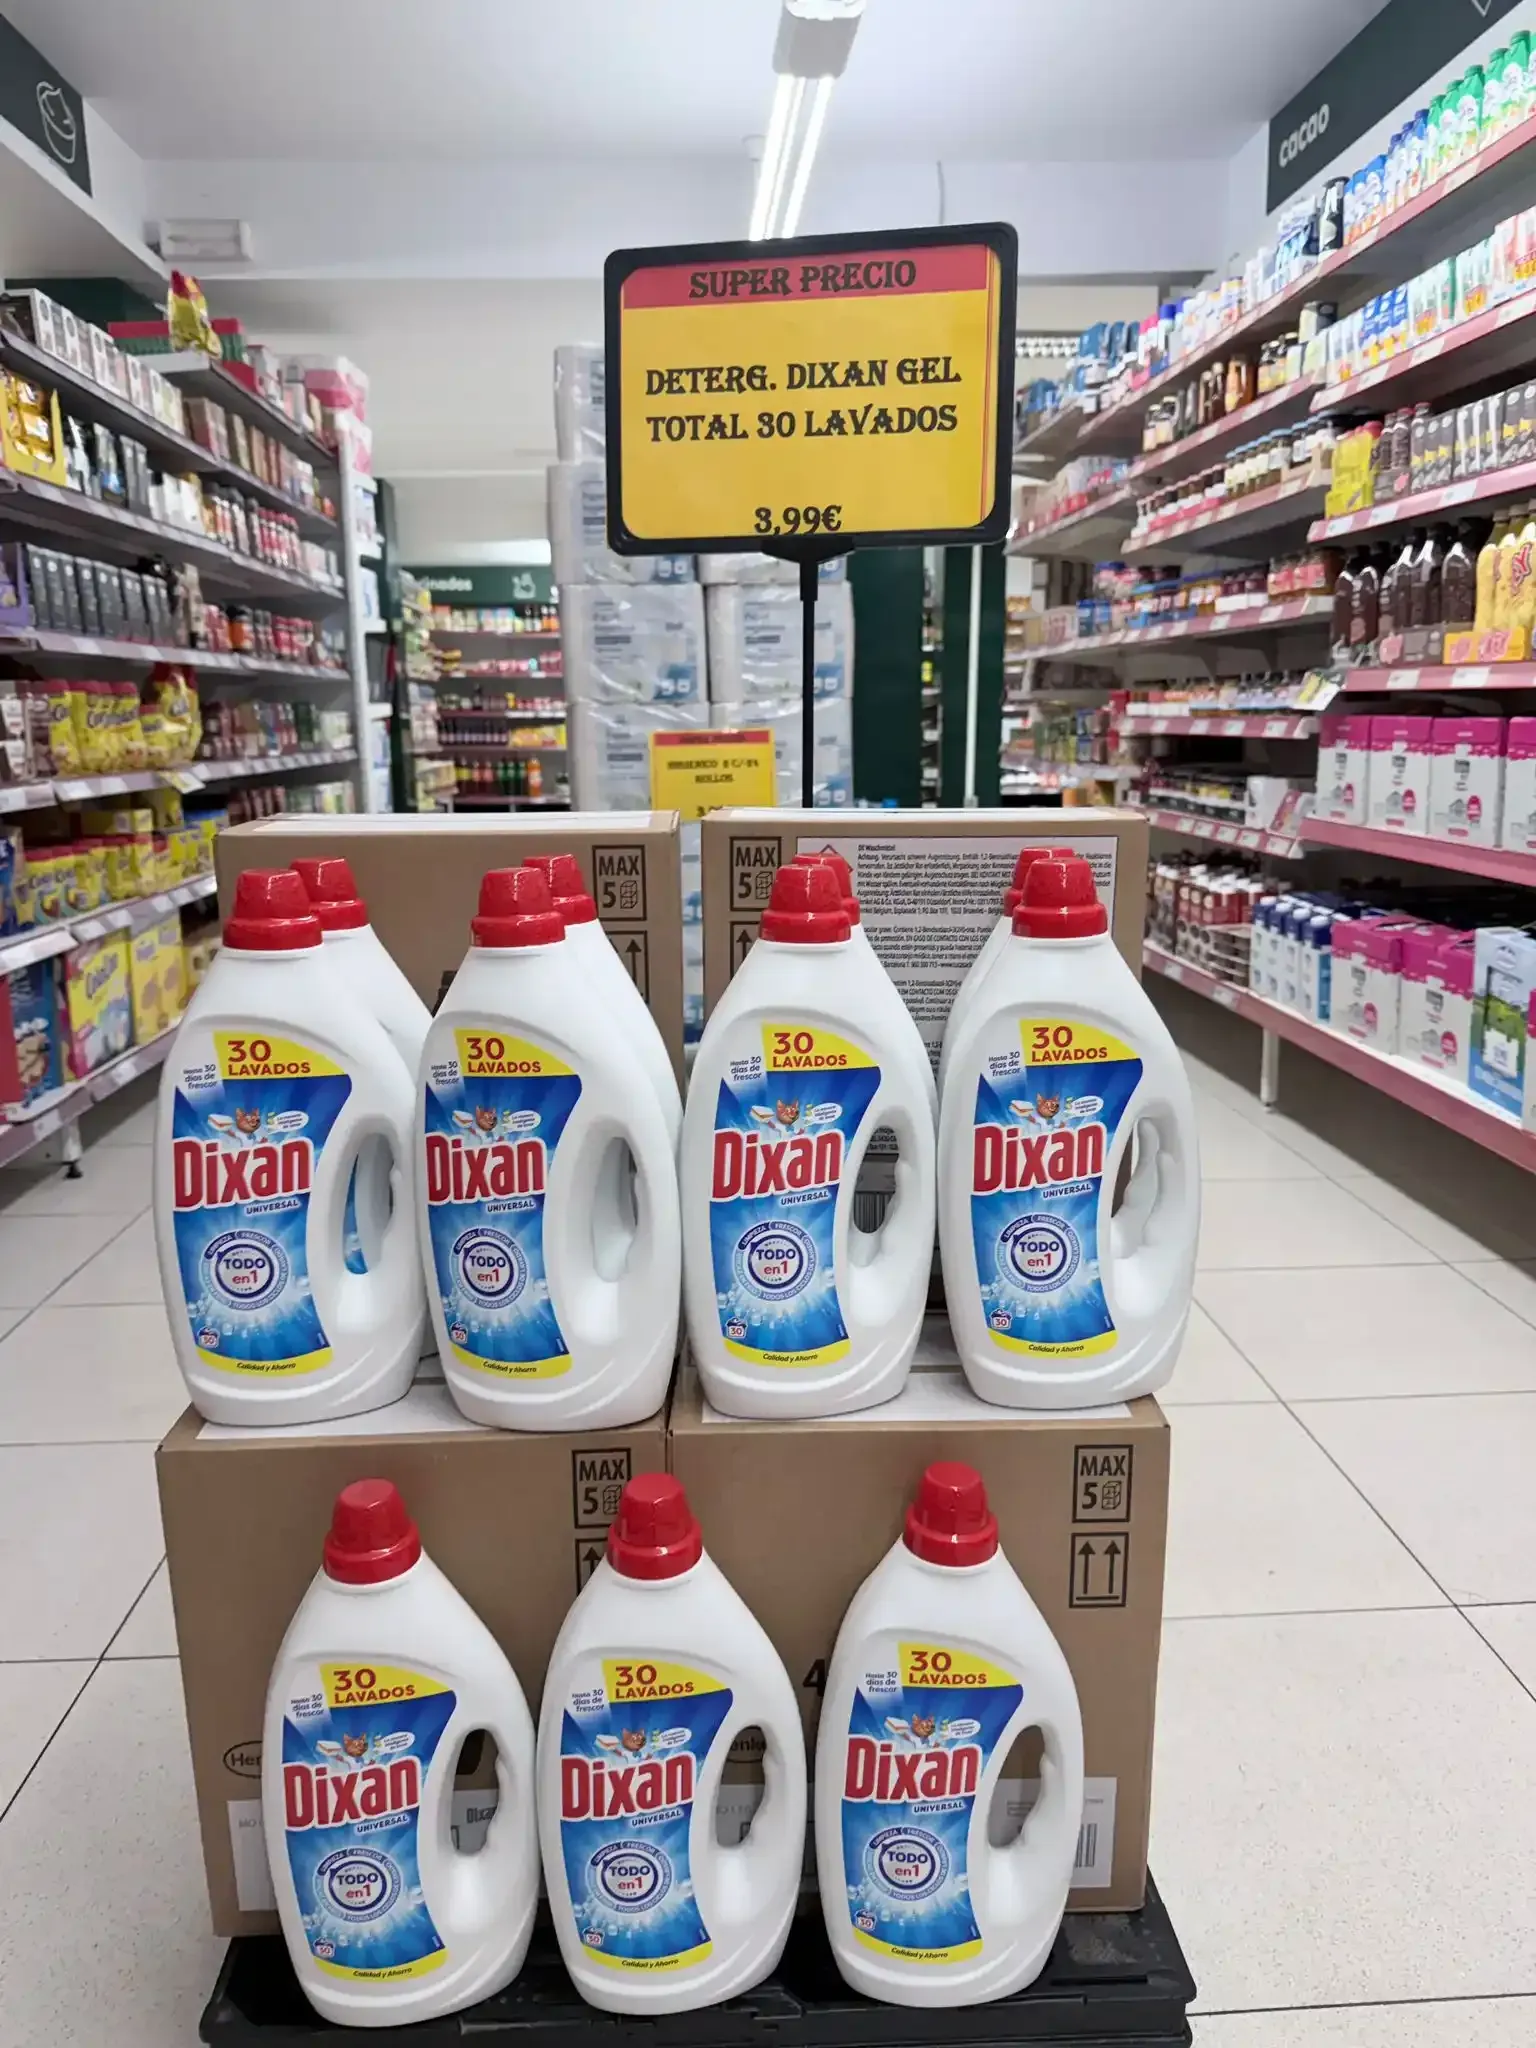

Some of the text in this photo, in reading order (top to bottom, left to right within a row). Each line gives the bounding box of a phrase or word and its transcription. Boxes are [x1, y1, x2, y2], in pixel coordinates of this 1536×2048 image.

[1279, 103, 1330, 168] cacao
[689, 260, 917, 298] SUPER PRECIO
[646, 356, 961, 395] DETERG. DIXAN GEL
[645, 403, 957, 442] TOTAL 30 LAVADOS
[754, 505, 842, 536] 3,99€
[736, 846, 777, 868] MAX
[599, 855, 640, 876] MAX
[738, 872, 752, 899] 5
[602, 881, 617, 908] 5
[773, 1032, 813, 1054] 30
[1032, 1026, 1073, 1049] 30
[228, 1040, 271, 1062] 30
[466, 1037, 505, 1060] 30
[1009, 1051, 1020, 1059] 30
[1032, 1047, 1108, 1062] LAVADOS
[750, 1056, 761, 1064] 30
[773, 1054, 847, 1068] LAVADOS
[989, 1061, 1007, 1070] días
[228, 1062, 311, 1076] LAVADOS
[448, 1069, 457, 1077] de
[468, 1061, 541, 1074] LAVADOS
[730, 1064, 760, 1074] días de
[992, 1067, 1021, 1077] frescor
[204, 1073, 215, 1081] de
[733, 1072, 762, 1081] frescor
[712, 1131, 840, 1199] Dixan
[973, 1124, 1103, 1193] Dixan
[173, 1139, 311, 1208] Dixan
[426, 1135, 545, 1202] Dixan
[780, 1191, 829, 1205] UNIVERSAL
[1042, 1184, 1091, 1199] UNIVERSAL
[246, 1199, 298, 1214] UNIVERSAL
[487, 1201, 534, 1213] UNIVERSAL
[756, 1248, 796, 1260] TODO
[1018, 1241, 1060, 1253] TODO
[223, 1258, 266, 1269] TODO
[469, 1255, 506, 1267] TODO
[995, 1318, 1007, 1327] 30
[730, 1327, 743, 1336] 30
[1028, 1344, 1055, 1353] Calidad
[1061, 1344, 1084, 1353] Ahorro
[763, 1353, 789, 1362] Calidad
[795, 1353, 818, 1362] Ahorro
[579, 1459, 625, 1481] MAX
[1080, 1455, 1126, 1476] MAX
[582, 1487, 598, 1514] 5
[1081, 1482, 1098, 1510] 5
[909, 1651, 952, 1672] 30
[333, 1668, 376, 1691] 30
[615, 1665, 657, 1687] 30
[885, 1678, 896, 1686] de
[886, 1671, 897, 1679] 30
[909, 1673, 987, 1685] LAVADOS
[334, 1684, 416, 1704] LAVADOS
[592, 1688, 604, 1697] 30
[615, 1681, 694, 1699] LAVADOS
[868, 1685, 897, 1694] frescor
[311, 1702, 322, 1710] de
[576, 1703, 605, 1712] frescor
[592, 1697, 602, 1705] de
[845, 1737, 979, 1800] Dixan
[283, 1758, 419, 1828] Dixan
[561, 1754, 693, 1818] Dixan
[914, 1802, 963, 1813] UNIVERSAL
[356, 1814, 408, 1833] UNIVERSAL
[632, 1811, 681, 1827] UNIVERSAL
[886, 1851, 928, 1863] TODO
[609, 1865, 650, 1877] TODO
[336, 1873, 378, 1886] TODO
[891, 1947, 918, 1958] Calidad
[924, 1951, 948, 1959] Ahorro
[621, 1959, 649, 1968] Calidad
[654, 1958, 679, 1968] Ahorro
